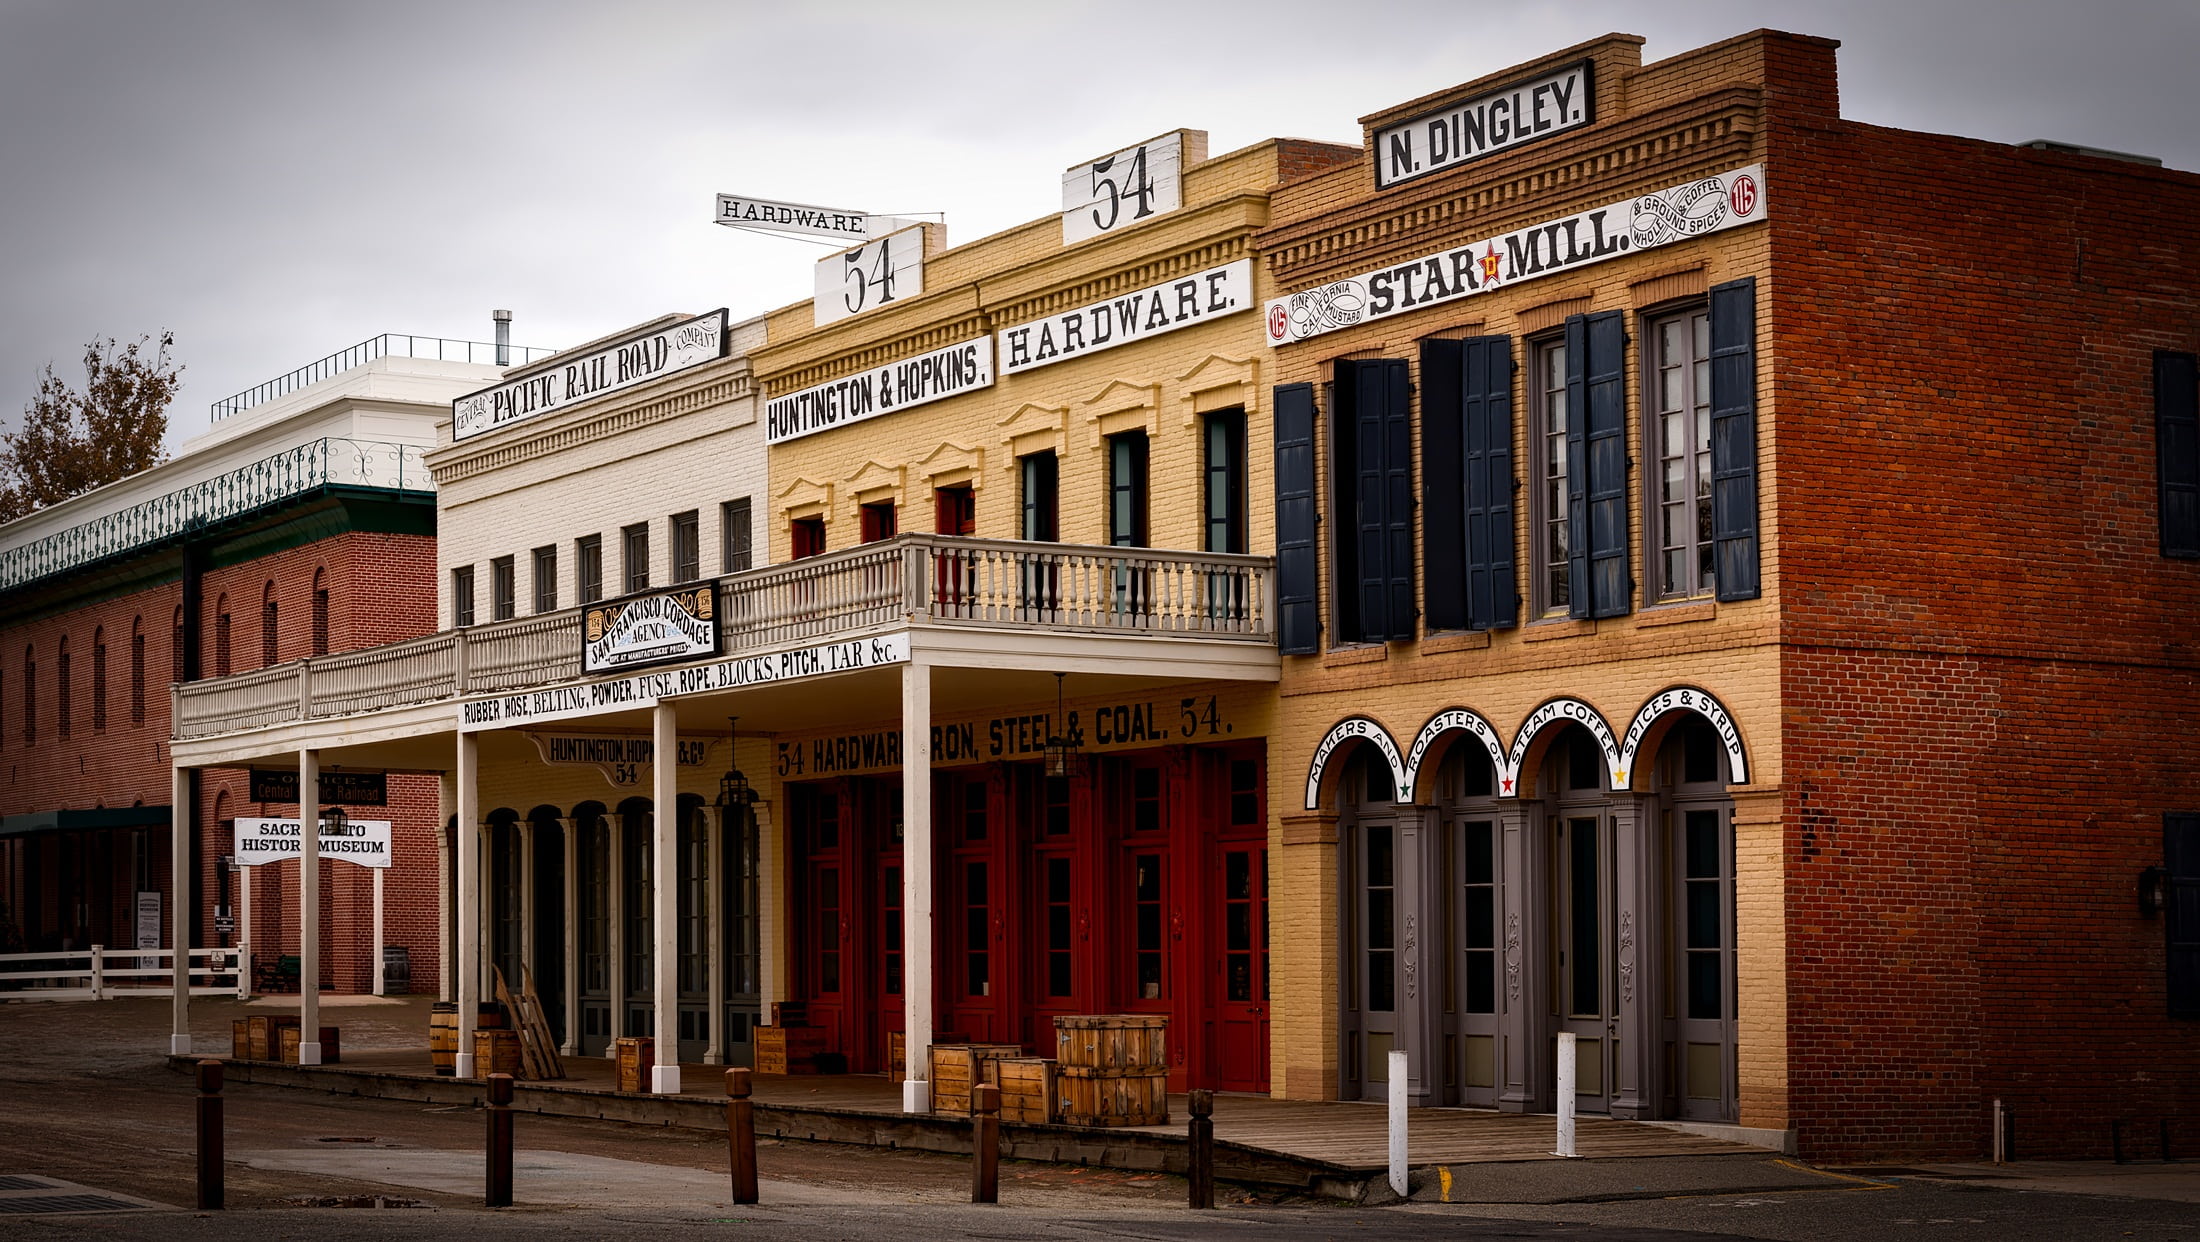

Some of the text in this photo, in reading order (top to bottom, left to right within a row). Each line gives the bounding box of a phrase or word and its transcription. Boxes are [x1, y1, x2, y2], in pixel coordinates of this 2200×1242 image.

[1390, 75, 1581, 177] N. DINGLEY.
[723, 200, 866, 234] HARDWARE.
[1091, 145, 1156, 230] 54
[1633, 179, 1727, 246] WHOLE & GROUND SPICES & COFFEE
[844, 238, 896, 313] 54
[1369, 249, 1480, 316] STAR
[1505, 211, 1630, 280] MILL.
[1008, 270, 1235, 368] HARDWARE.
[1291, 283, 1361, 335] FINE CALIFORNIA MUSTARD
[456, 327, 718, 430] CENTRAL PACIFIC RAIL ROAD COMPANY
[768, 345, 986, 440] HUNTINGTON & HOPKINS,
[592, 597, 710, 664] SAN FRANCISCO CORDAGE
[632, 622, 667, 643] AGENCY
[464, 700, 500, 724] RUBBER
[505, 695, 532, 719] HOSE,
[533, 687, 590, 715] BELTING,
[592, 679, 636, 706] POWDER,
[639, 672, 678, 700] FUSE,
[680, 666, 715, 692] ROPE,
[718, 656, 779, 687] BLOCKS,
[782, 648, 825, 677] PITCH,
[828, 641, 864, 670] TAR
[777, 742, 805, 776] 54
[930, 722, 979, 762] RON,
[989, 713, 1055, 755] STEEL
[1067, 711, 1084, 747] &
[1095, 702, 1169, 745] COAL.
[1311, 722, 1398, 783] MAKERS AND
[1408, 712, 1504, 772] ROASTERS OF
[1512, 702, 1618, 765] STEAM COFFEE
[1624, 690, 1740, 757] SPICES & SYRUP
[258, 783, 293, 801] Central
[337, 784, 379, 802] Railroad
[616, 763, 637, 783] 54
[242, 839, 384, 853] HISTOR MUSEUM
